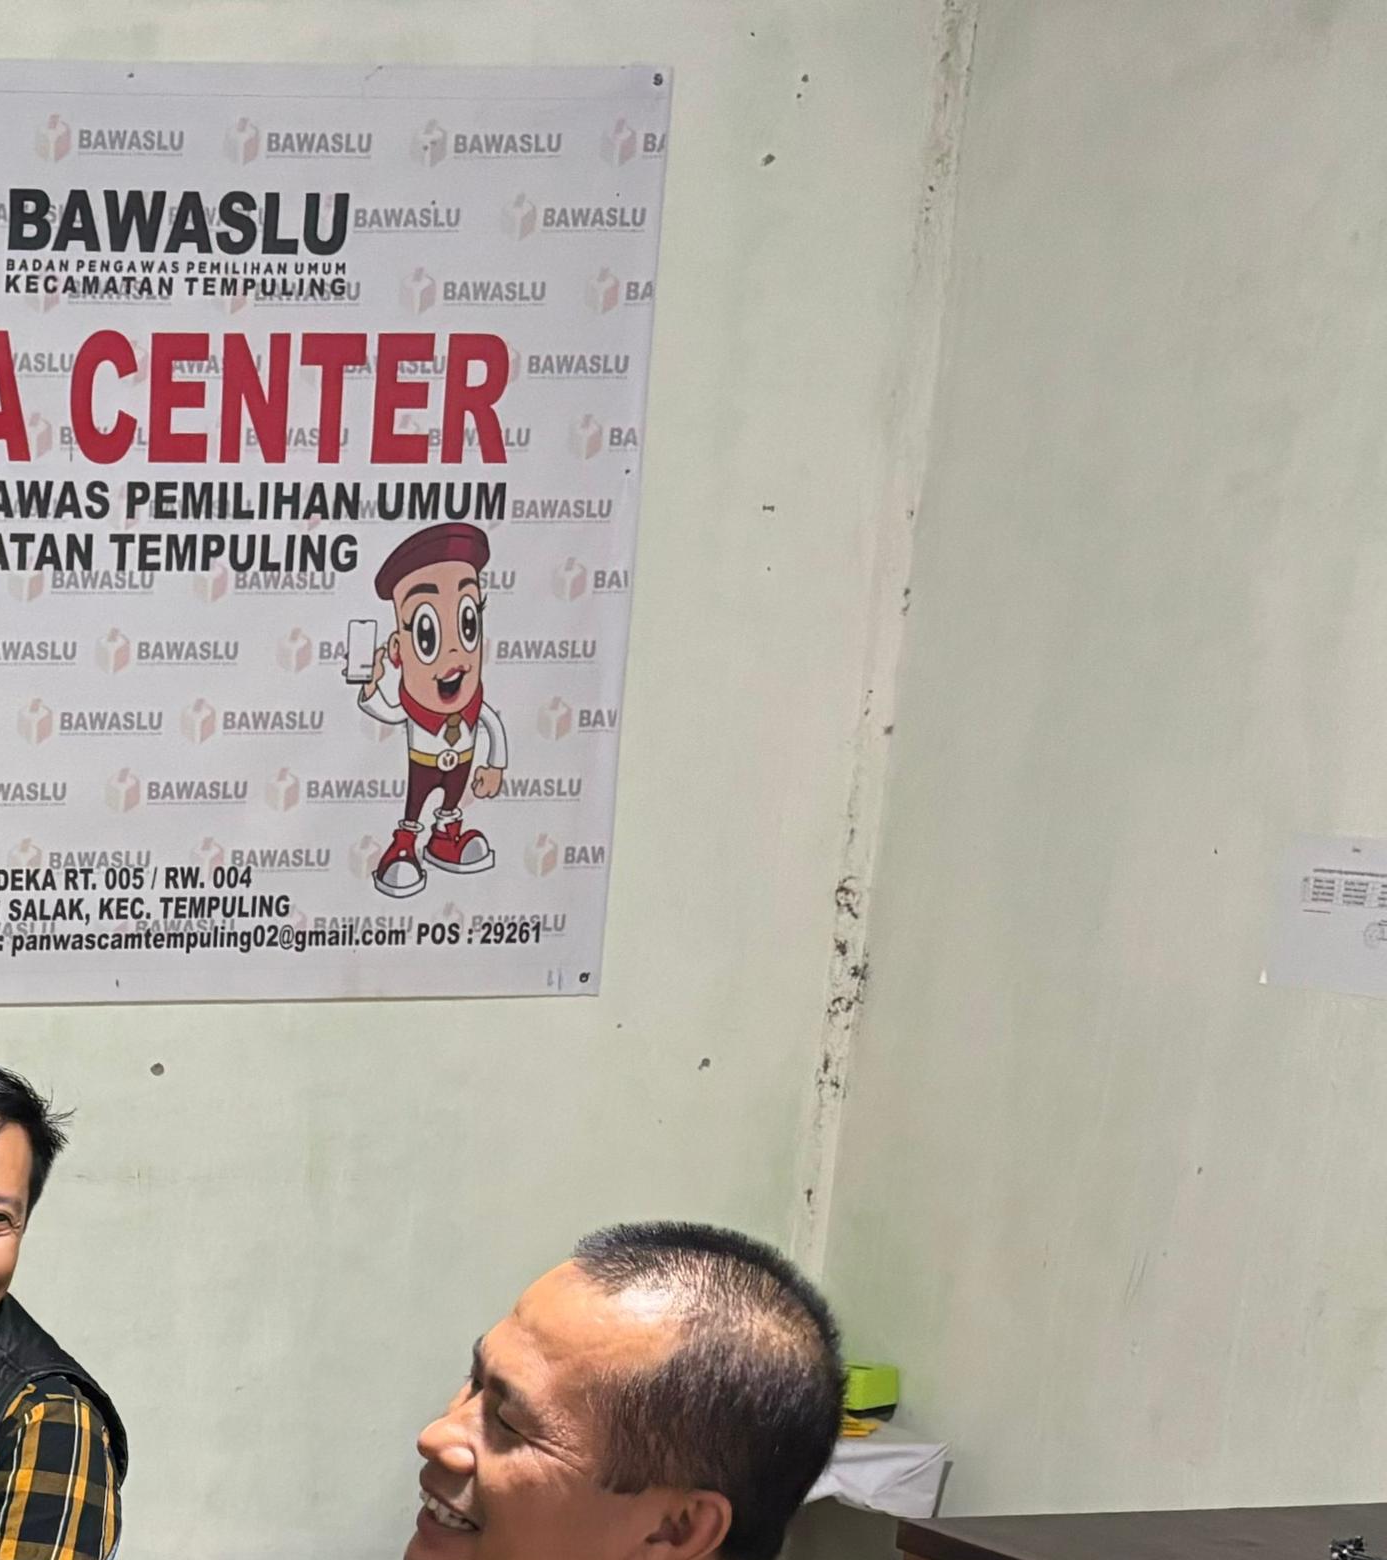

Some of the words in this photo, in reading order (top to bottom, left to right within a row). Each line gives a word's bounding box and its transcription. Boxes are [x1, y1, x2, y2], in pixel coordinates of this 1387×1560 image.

[77, 128, 185, 152] BAWASLU
[266, 131, 372, 155] BAWASLU
[453, 132, 563, 154] BAWASLU
[7, 187, 351, 256] BAWASLU
[353, 207, 461, 229] BAWASLU
[542, 206, 647, 228] BAWASLU
[6, 258, 69, 273] BADAN
[76, 259, 180, 274] PENGAWAS
[186, 261, 288, 276] PEMILIHAN
[294, 261, 347, 276] UMUM
[4, 274, 174, 296] KECAMATAN
[185, 277, 347, 297] TEMPULING
[442, 280, 547, 302] BAWASLU
[527, 354, 630, 375] BAWASLU
[70, 329, 510, 465] CENTER
[126, 481, 361, 521] PEMILIHAN
[377, 481, 507, 521] UMUM
[511, 499, 612, 519] BAWASLU
[109, 533, 358, 573] TEMPULING
[51, 570, 155, 590] BAWASLU
[234, 571, 336, 590] BAWASLU
[136, 641, 239, 660] BAWASLU
[496, 640, 597, 659] BAWASLU
[59, 711, 163, 731] BAWASLU
[222, 711, 324, 731] BAWASLU
[147, 781, 248, 801] BAWASLU
[306, 780, 405, 799] BAWASLU
[500, 778, 582, 797] AWASLU
[49, 850, 151, 870] BAWASLU
[230, 848, 330, 868] BAWASLU
[64, 868, 97, 891] RT.
[104, 866, 145, 890] 005
[150, 866, 158, 890] /
[164, 866, 205, 890] RW.
[212, 865, 252, 889] 004
[8, 897, 91, 926] SALAK,
[98, 897, 152, 921] KEC.
[159, 894, 291, 920] TEMPULING
[11, 923, 406, 957] panwascamtempuling02@gmail.com
[416, 922, 461, 946] POS
[479, 921, 542, 945] 29261
